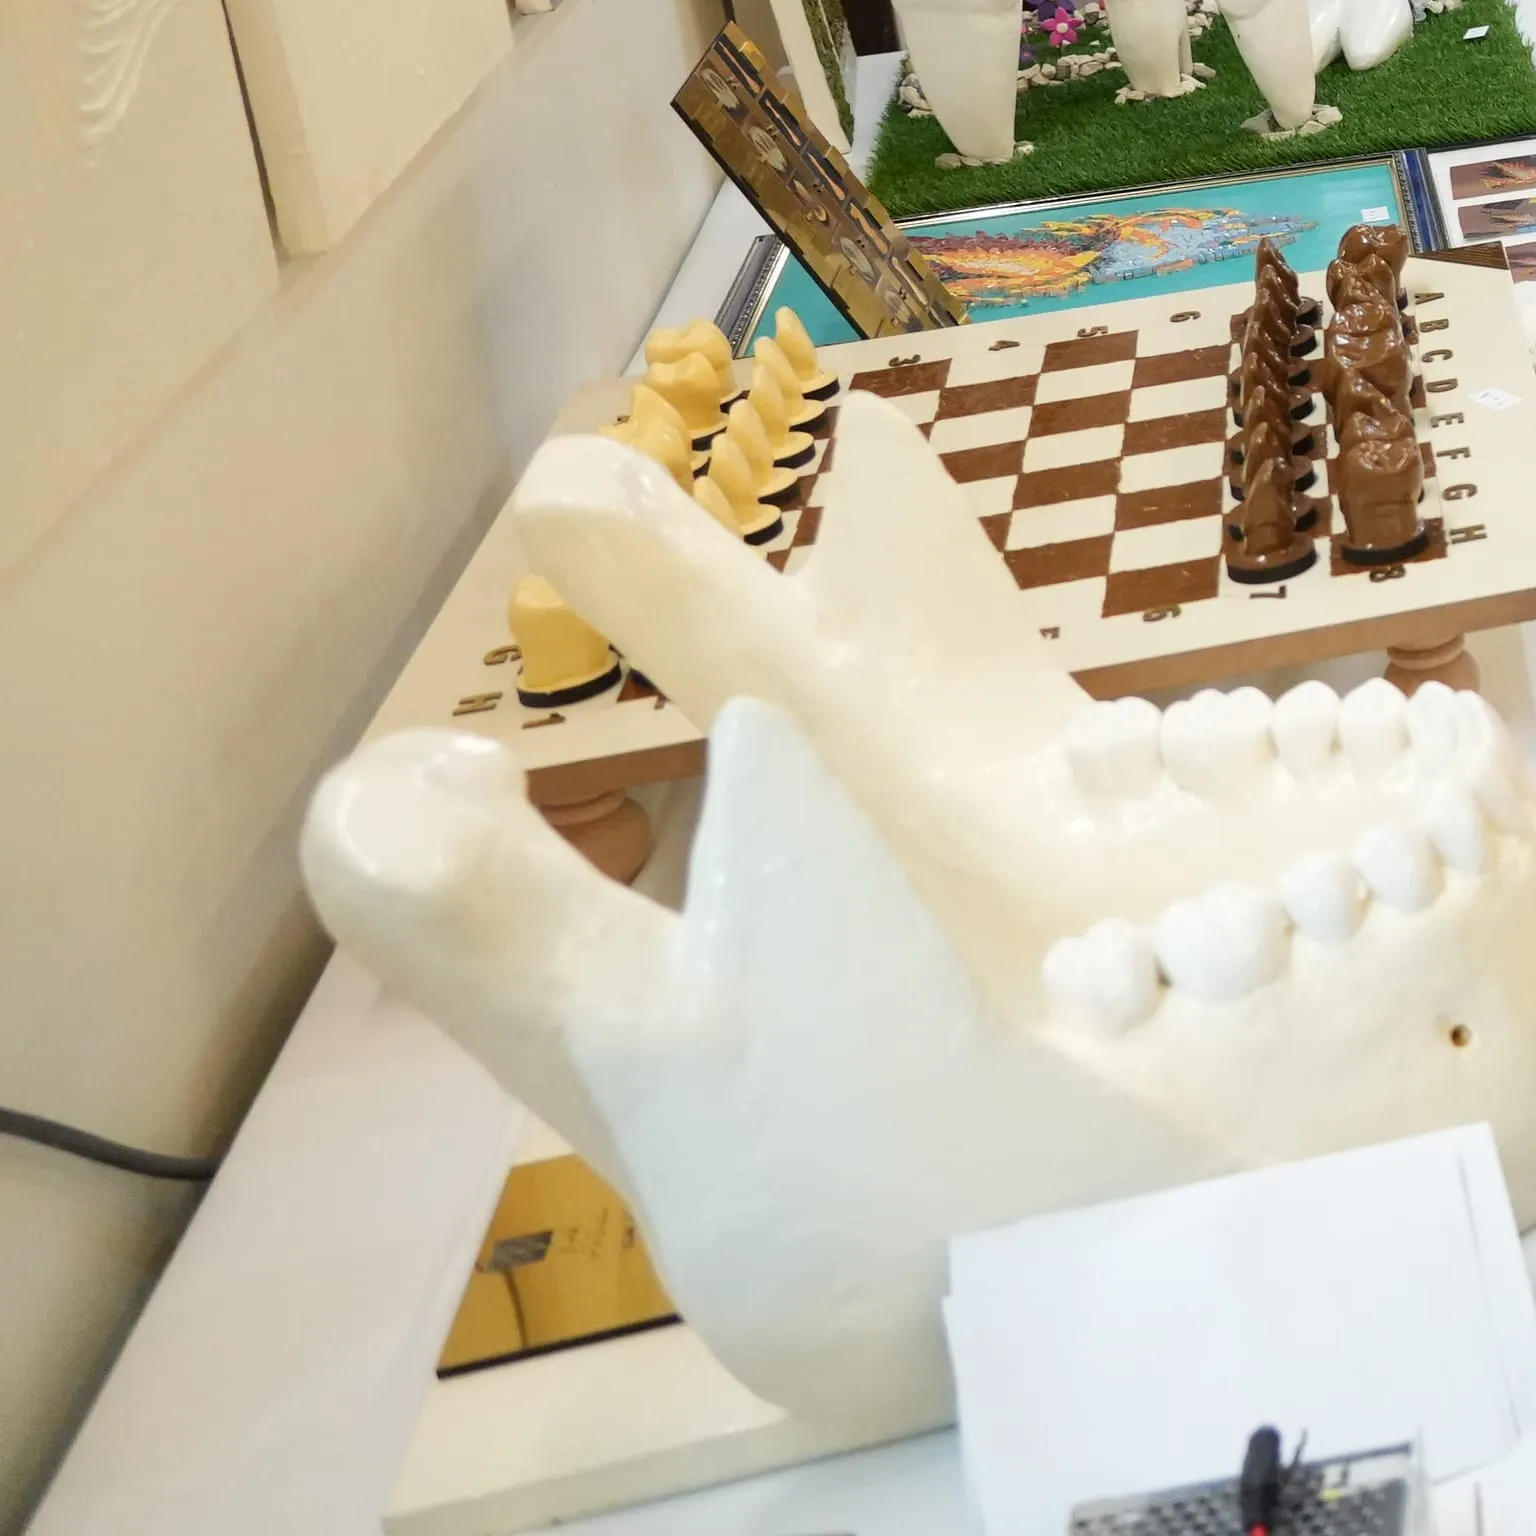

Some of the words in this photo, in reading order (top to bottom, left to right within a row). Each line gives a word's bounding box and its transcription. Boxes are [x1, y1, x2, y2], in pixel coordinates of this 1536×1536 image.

[1414, 292, 1444, 305] A
[988, 340, 1019, 351] 4
[1077, 325, 1108, 338] 5
[1170, 311, 1201, 323] 6
[1419, 319, 1449, 332] B
[1421, 349, 1453, 363] C
[1426, 378, 1458, 393] D
[1430, 412, 1465, 428] E
[1436, 447, 1471, 460] F
[1442, 483, 1478, 501] G
[1450, 524, 1488, 545] H
[522, 713, 566, 729] 1
[1142, 603, 1182, 622] 6
[1249, 585, 1287, 599] 7
[1369, 565, 1405, 582] 8
[452, 692, 503, 716] H
